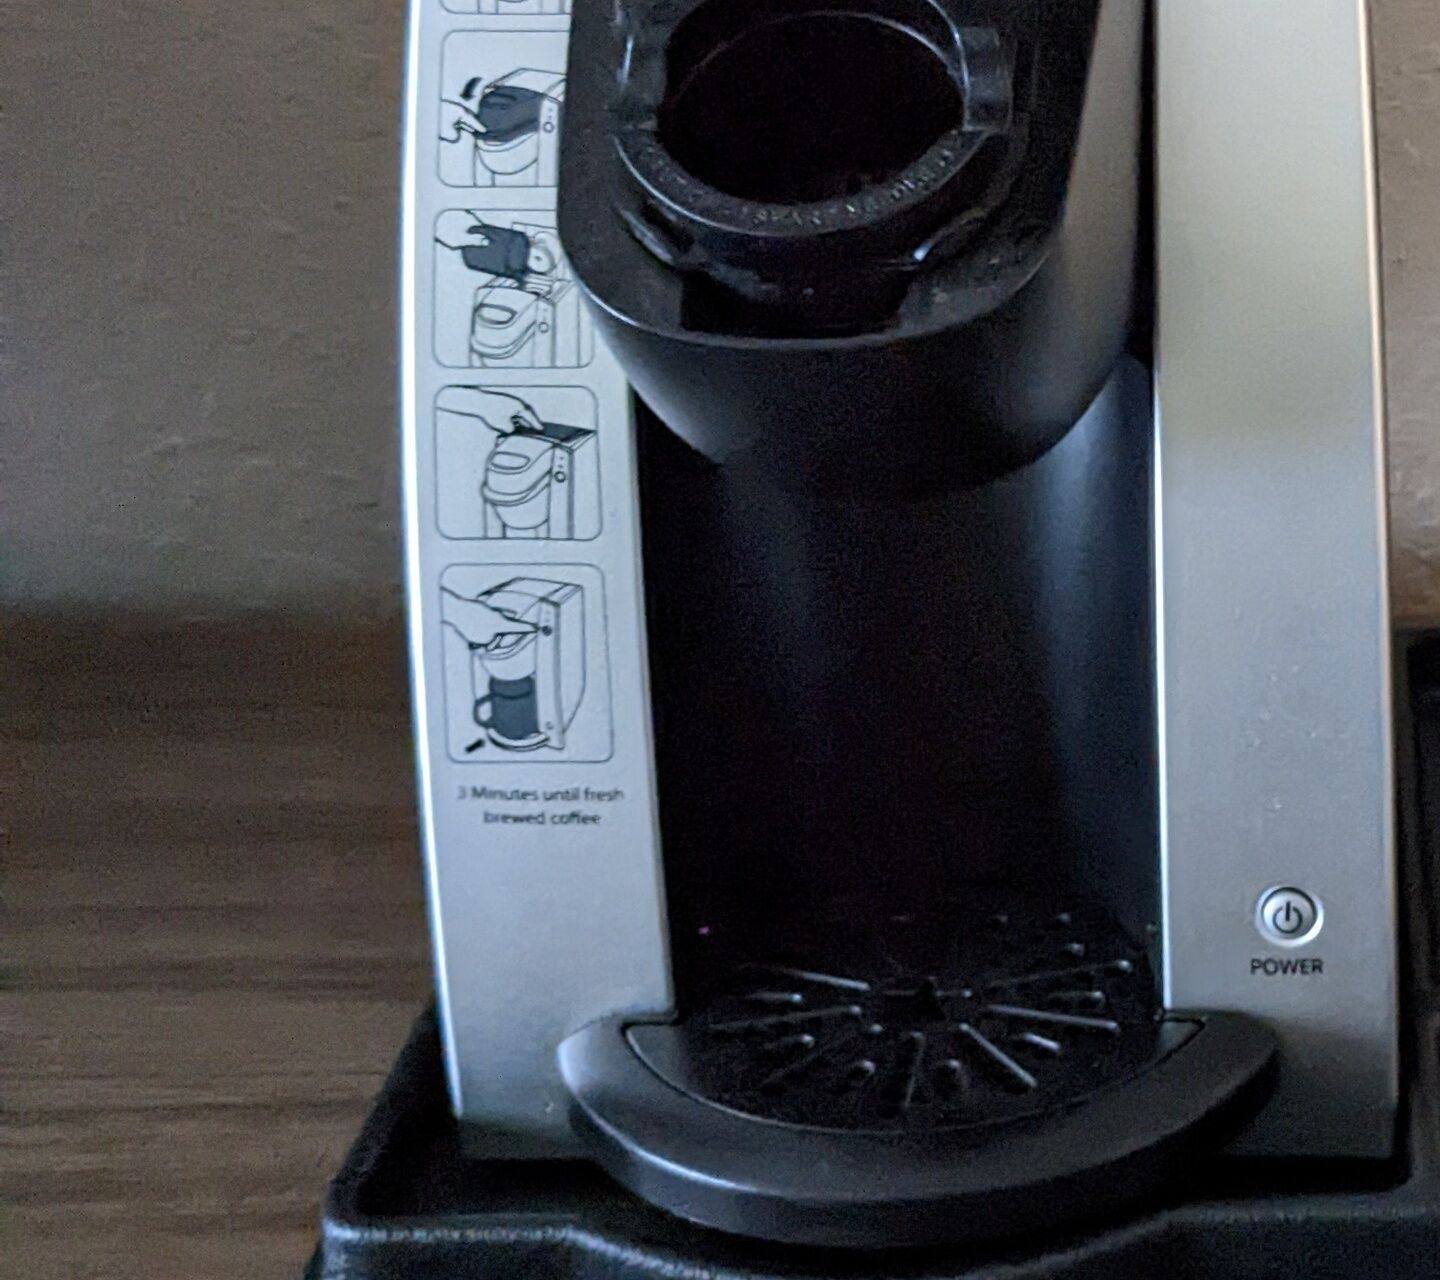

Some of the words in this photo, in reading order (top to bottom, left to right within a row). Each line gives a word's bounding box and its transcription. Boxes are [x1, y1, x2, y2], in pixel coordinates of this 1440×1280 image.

[458, 786, 467, 800] 3
[472, 786, 539, 801] Minutes
[543, 787, 580, 801] until
[584, 787, 625, 801] fresh
[483, 811, 545, 826] brewed
[551, 811, 601, 826] coffee
[1250, 957, 1323, 976] POWER
